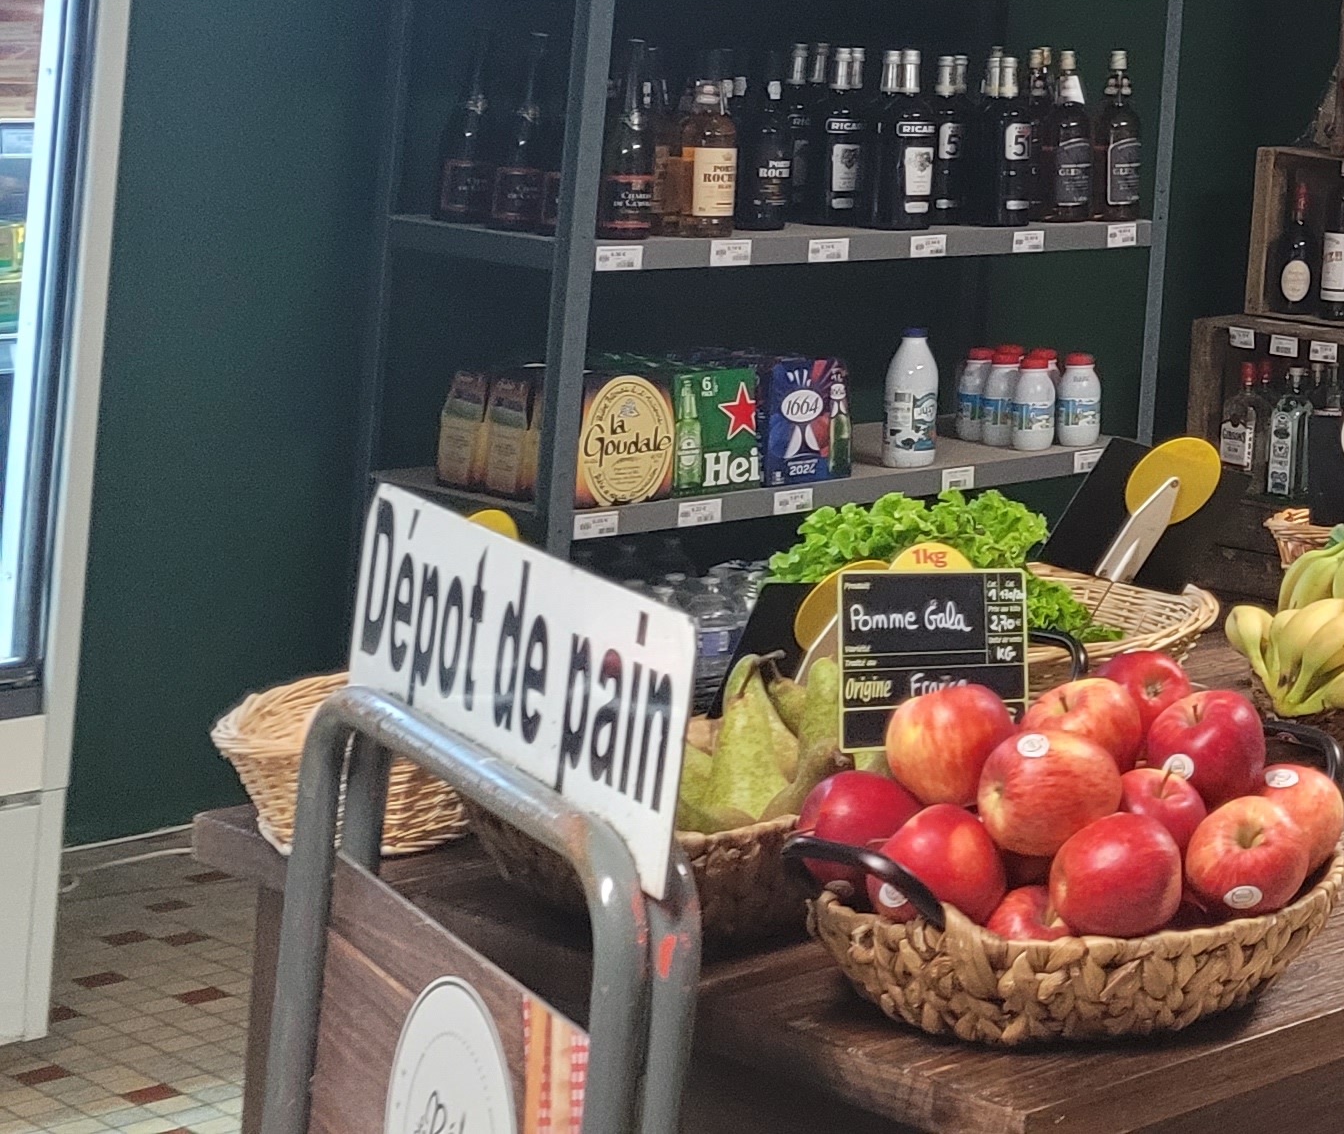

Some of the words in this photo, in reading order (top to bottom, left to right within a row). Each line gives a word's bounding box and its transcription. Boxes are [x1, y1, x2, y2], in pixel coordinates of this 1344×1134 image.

[701, 376, 712, 391] 6
[786, 399, 820, 417] 1664
[609, 414, 629, 436] la
[583, 426, 672, 469] Goudale
[702, 447, 761, 488] Hei
[912, 548, 948, 568] 1kg
[850, 603, 919, 632] Pomme
[924, 600, 973, 632] Gala
[996, 646, 1017, 661] KG
[493, 559, 550, 744] de
[555, 611, 674, 813] pain
[845, 675, 893, 703] Origine
